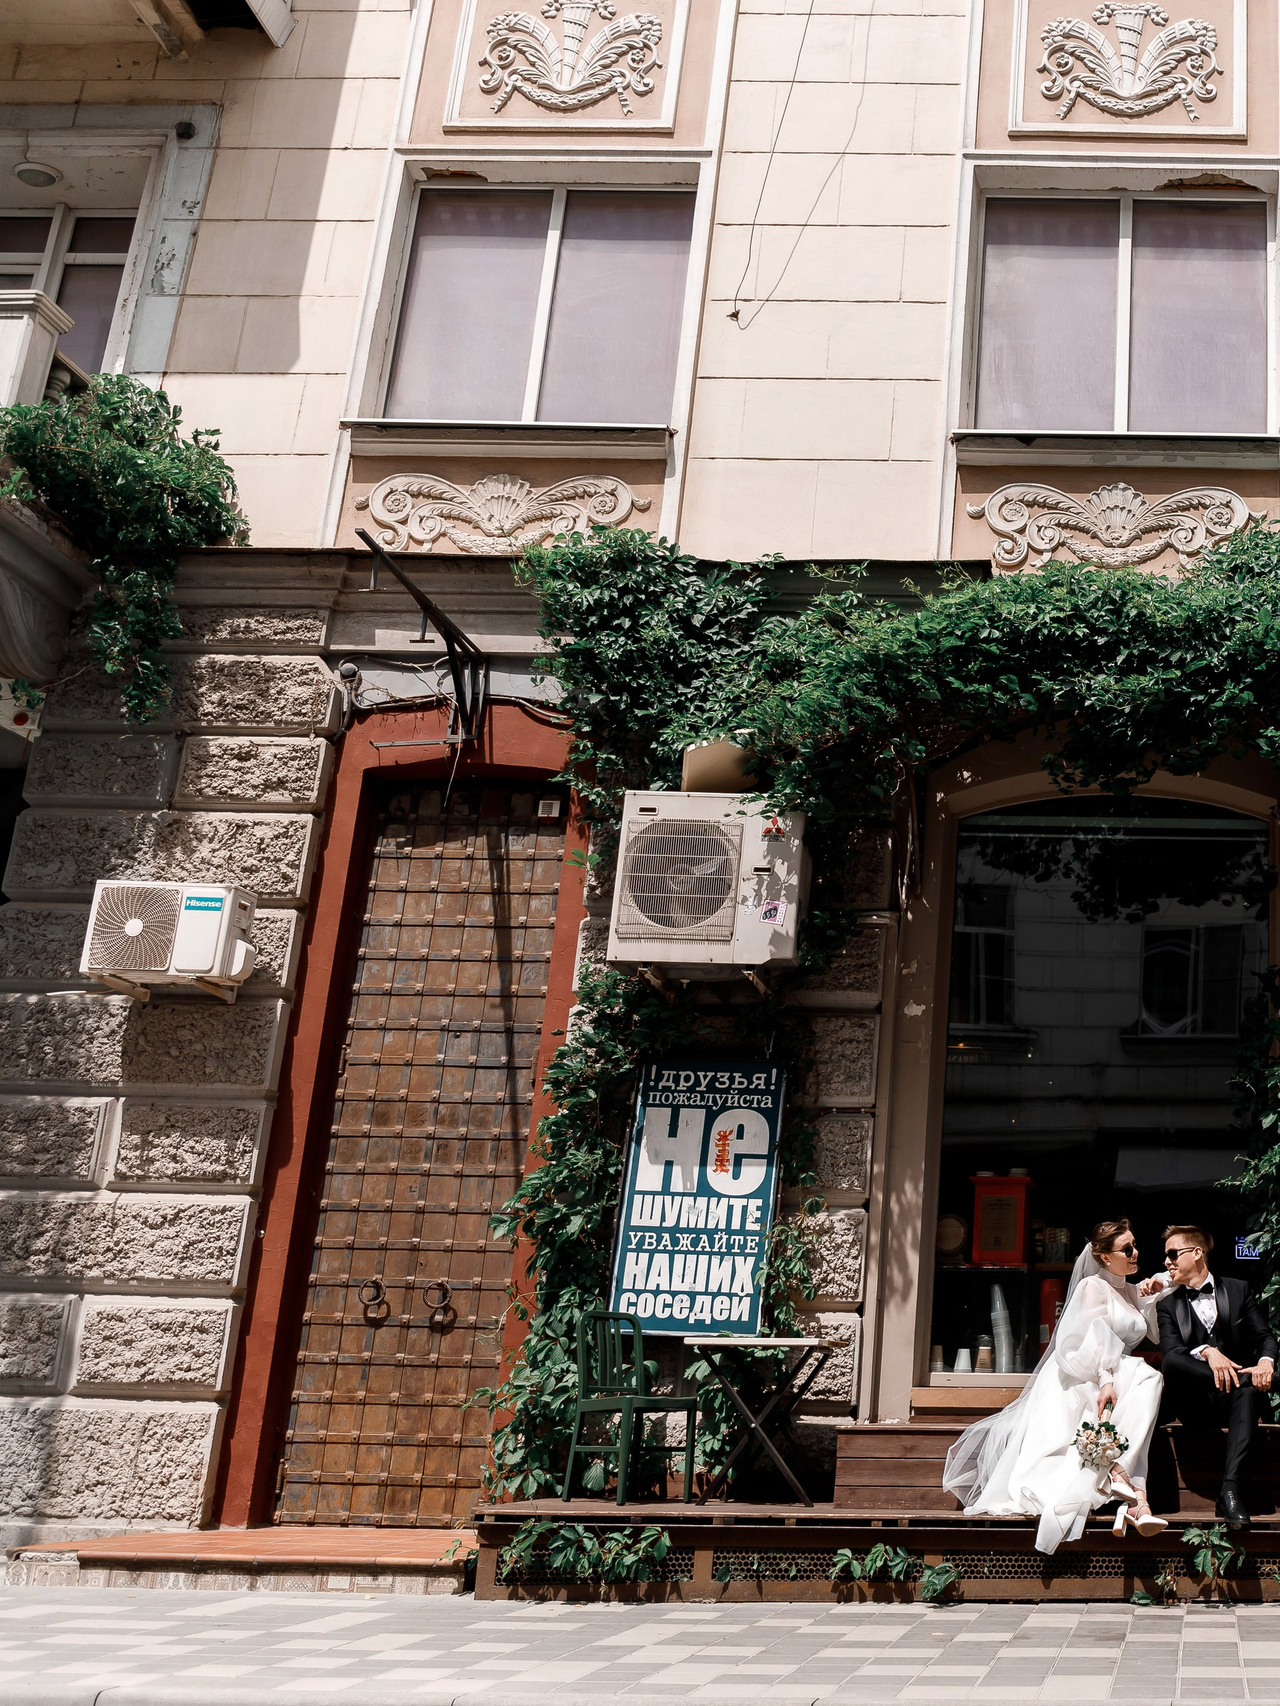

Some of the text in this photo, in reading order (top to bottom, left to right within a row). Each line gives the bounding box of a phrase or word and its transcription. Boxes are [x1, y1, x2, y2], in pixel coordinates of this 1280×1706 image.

[186, 899, 222, 908] Hisense
[647, 1090, 773, 1110] пожалуйста
[630, 1194, 763, 1231] ШУМИТЕ
[627, 1232, 760, 1253] УВАЖАЙТЕ
[622, 1251, 756, 1294] НАШИХ
